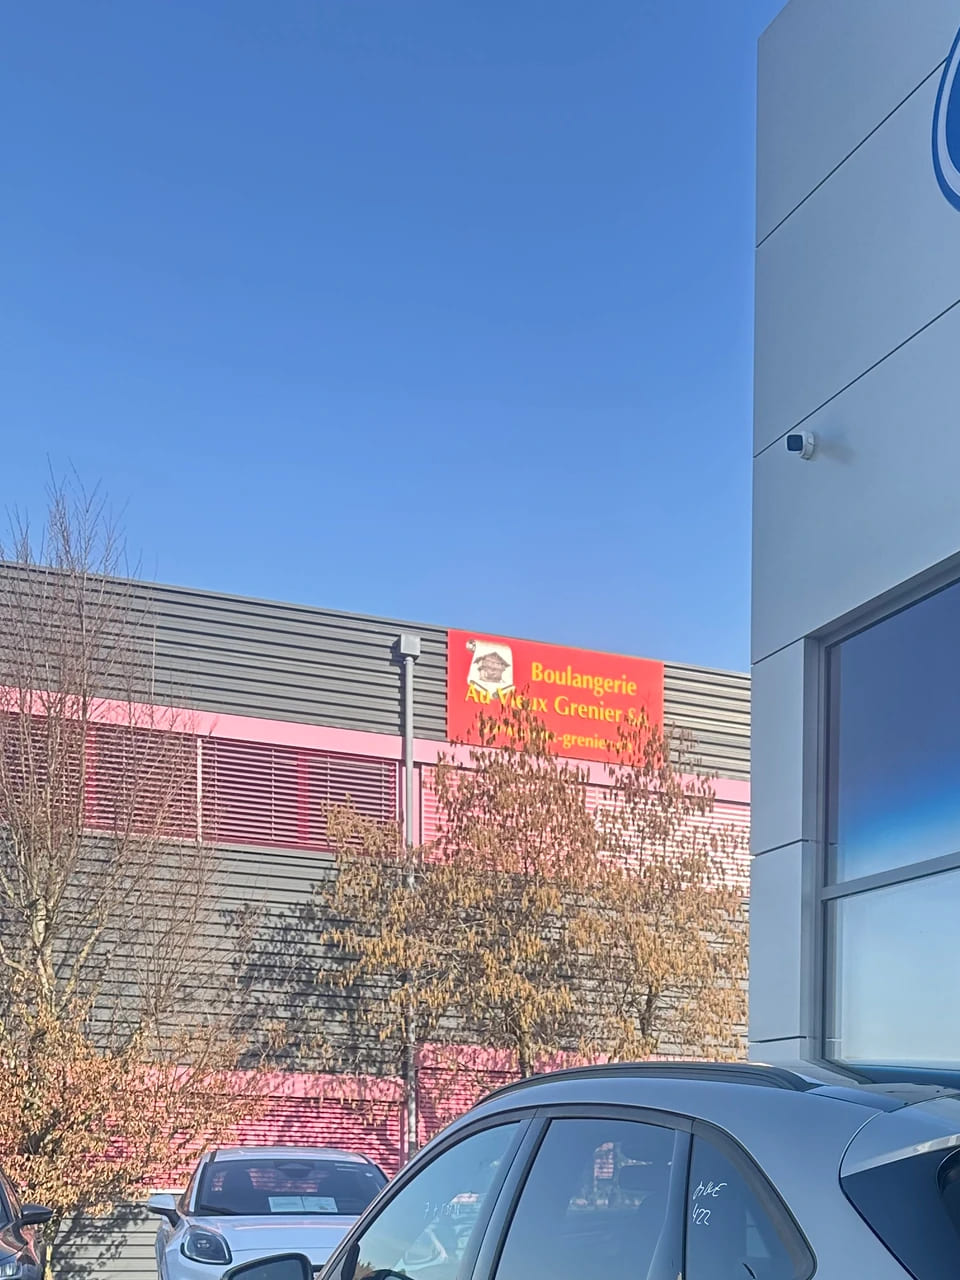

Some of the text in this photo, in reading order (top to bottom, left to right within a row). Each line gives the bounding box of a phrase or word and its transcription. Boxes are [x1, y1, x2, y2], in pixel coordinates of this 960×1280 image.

[531, 661, 638, 696] Boulangerie
[465, 683, 491, 705] Au
[554, 695, 623, 723] Grenier
